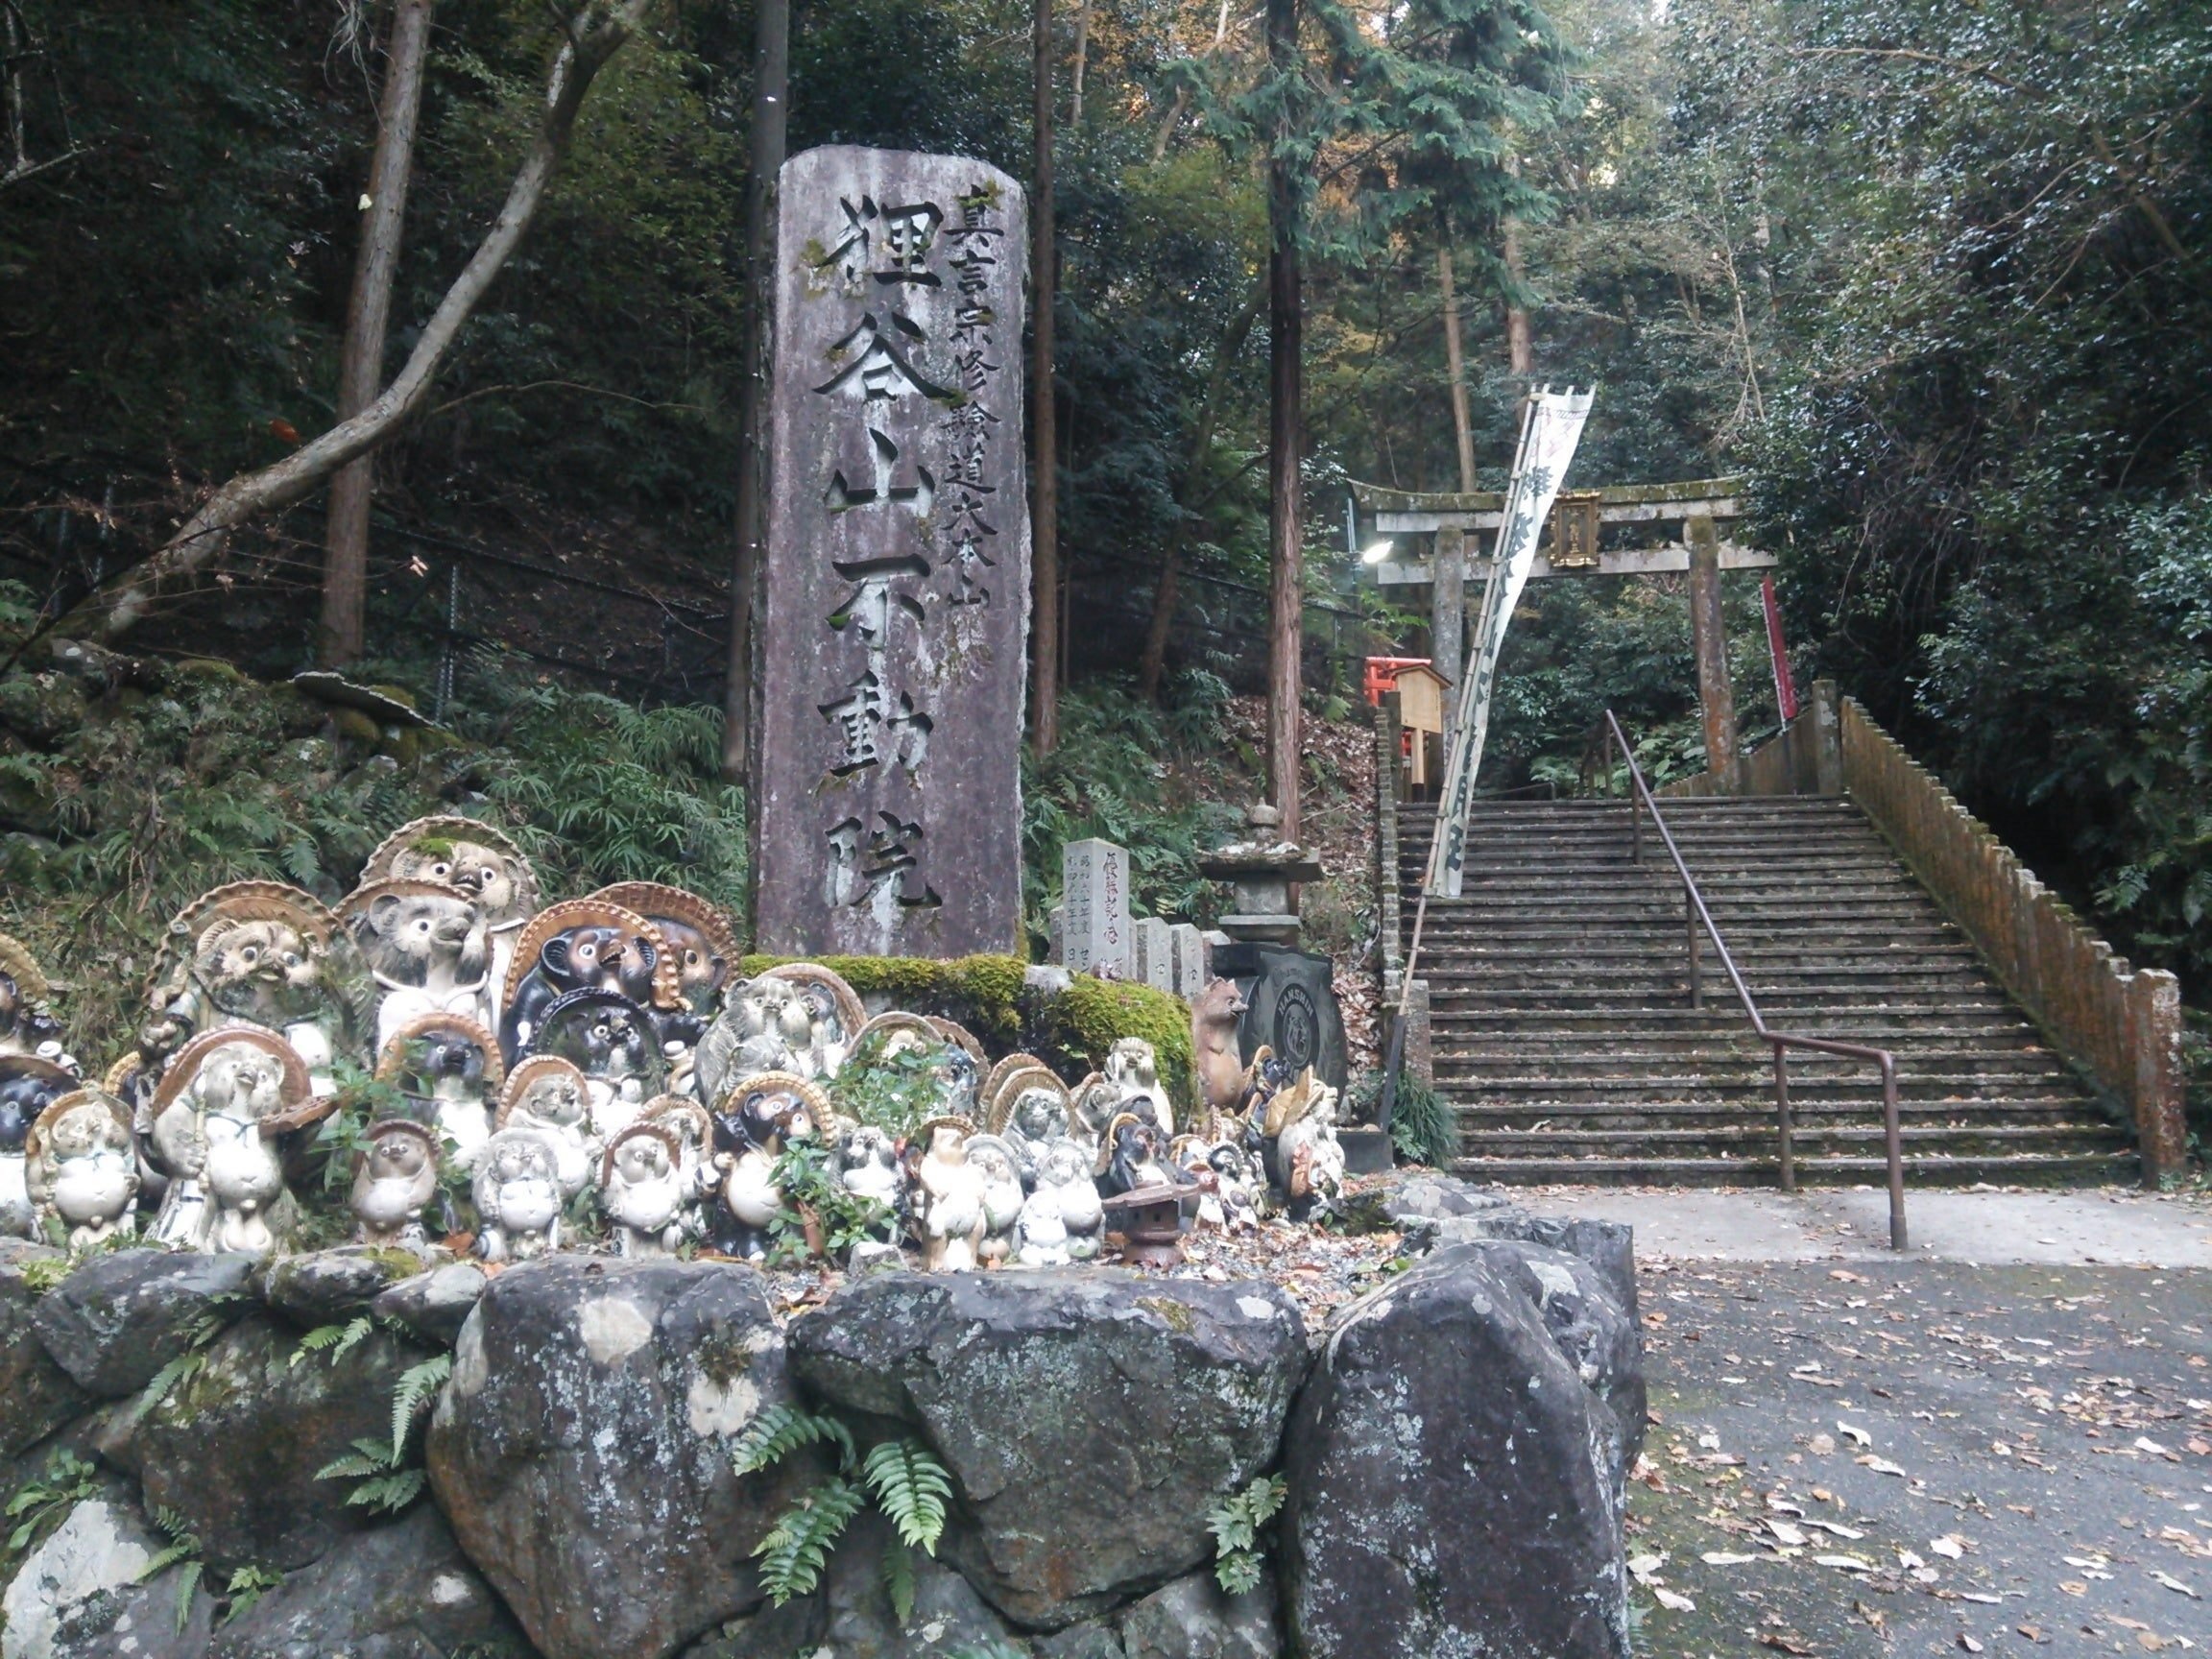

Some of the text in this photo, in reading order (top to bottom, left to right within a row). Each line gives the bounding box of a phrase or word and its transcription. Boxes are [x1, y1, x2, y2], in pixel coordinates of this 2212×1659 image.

[812, 194, 954, 909] 狸谷山不動院
[1278, 989, 1314, 1018] HANSHIN
